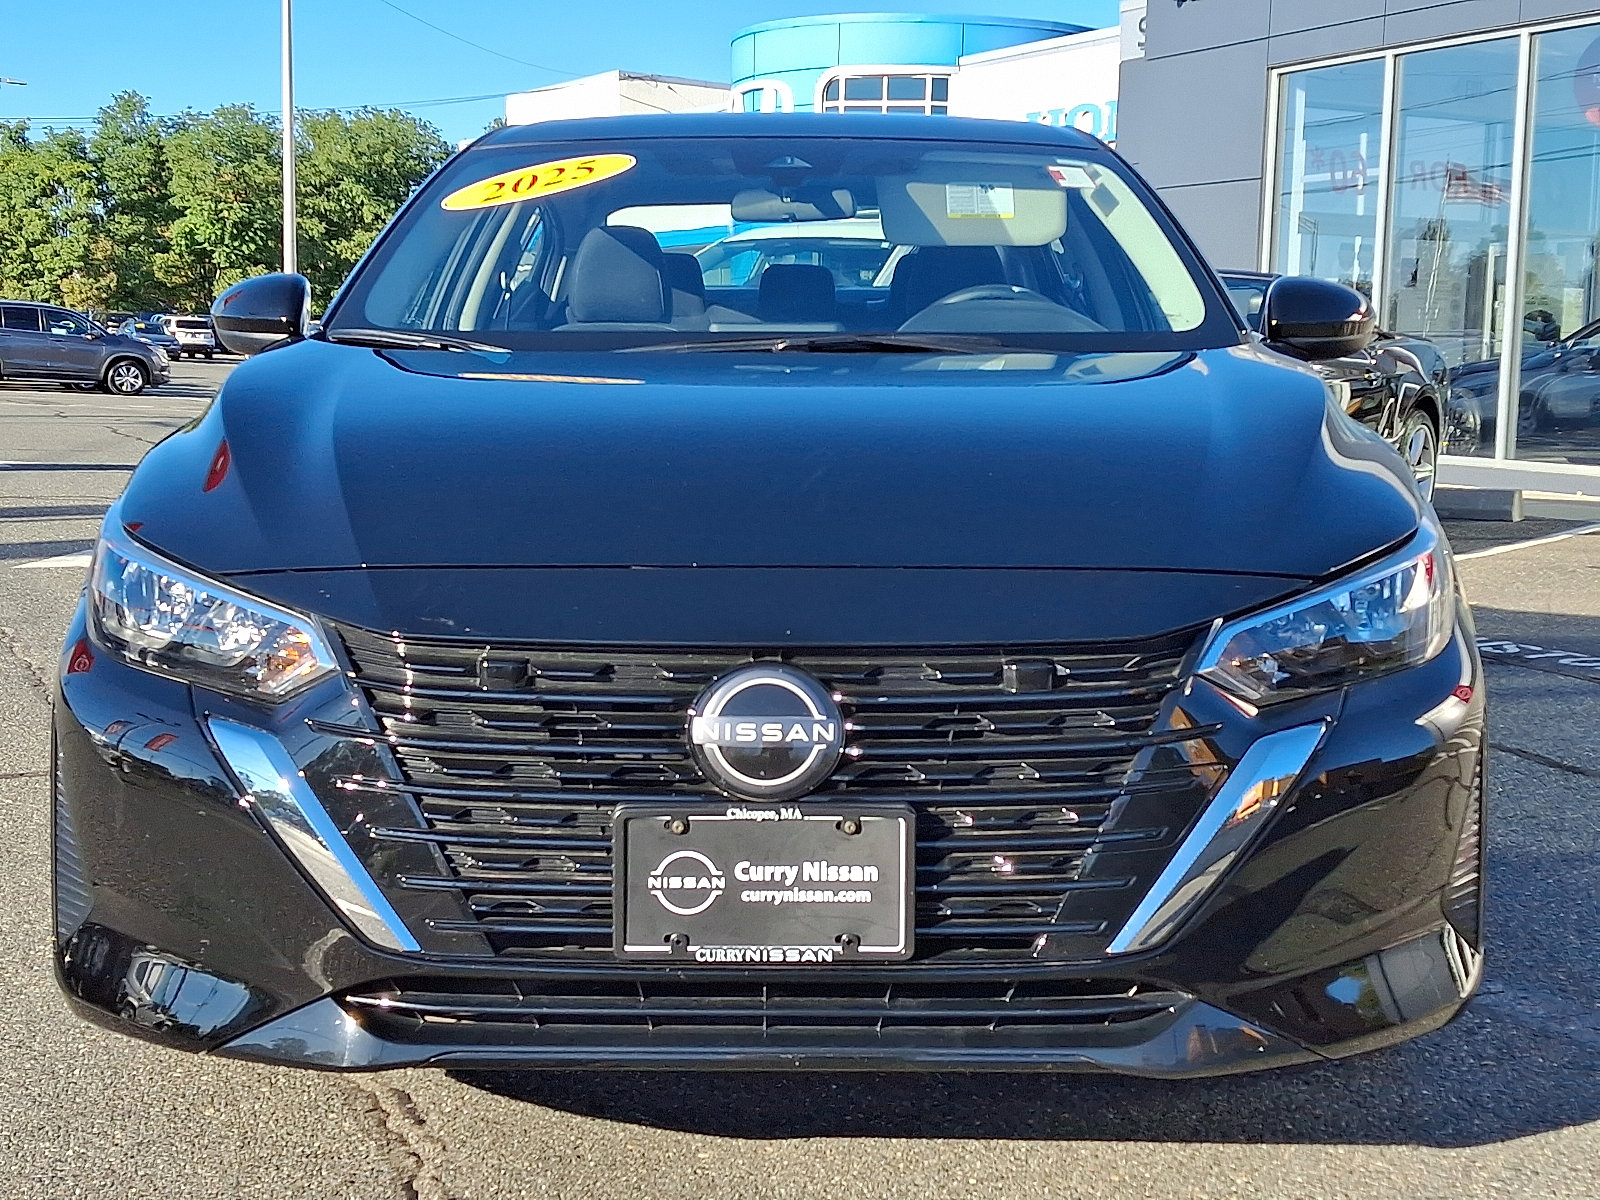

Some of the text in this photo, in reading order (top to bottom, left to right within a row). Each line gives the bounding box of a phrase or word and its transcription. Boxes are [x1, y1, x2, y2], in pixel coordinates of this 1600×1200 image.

[481, 160, 596, 203] 2025
[699, 722, 835, 742] NISSAN
[780, 807, 802, 819] MA
[647, 876, 726, 889] NISSAN
[734, 860, 879, 887] Curry Nissan
[740, 886, 872, 906] currynissan.com
